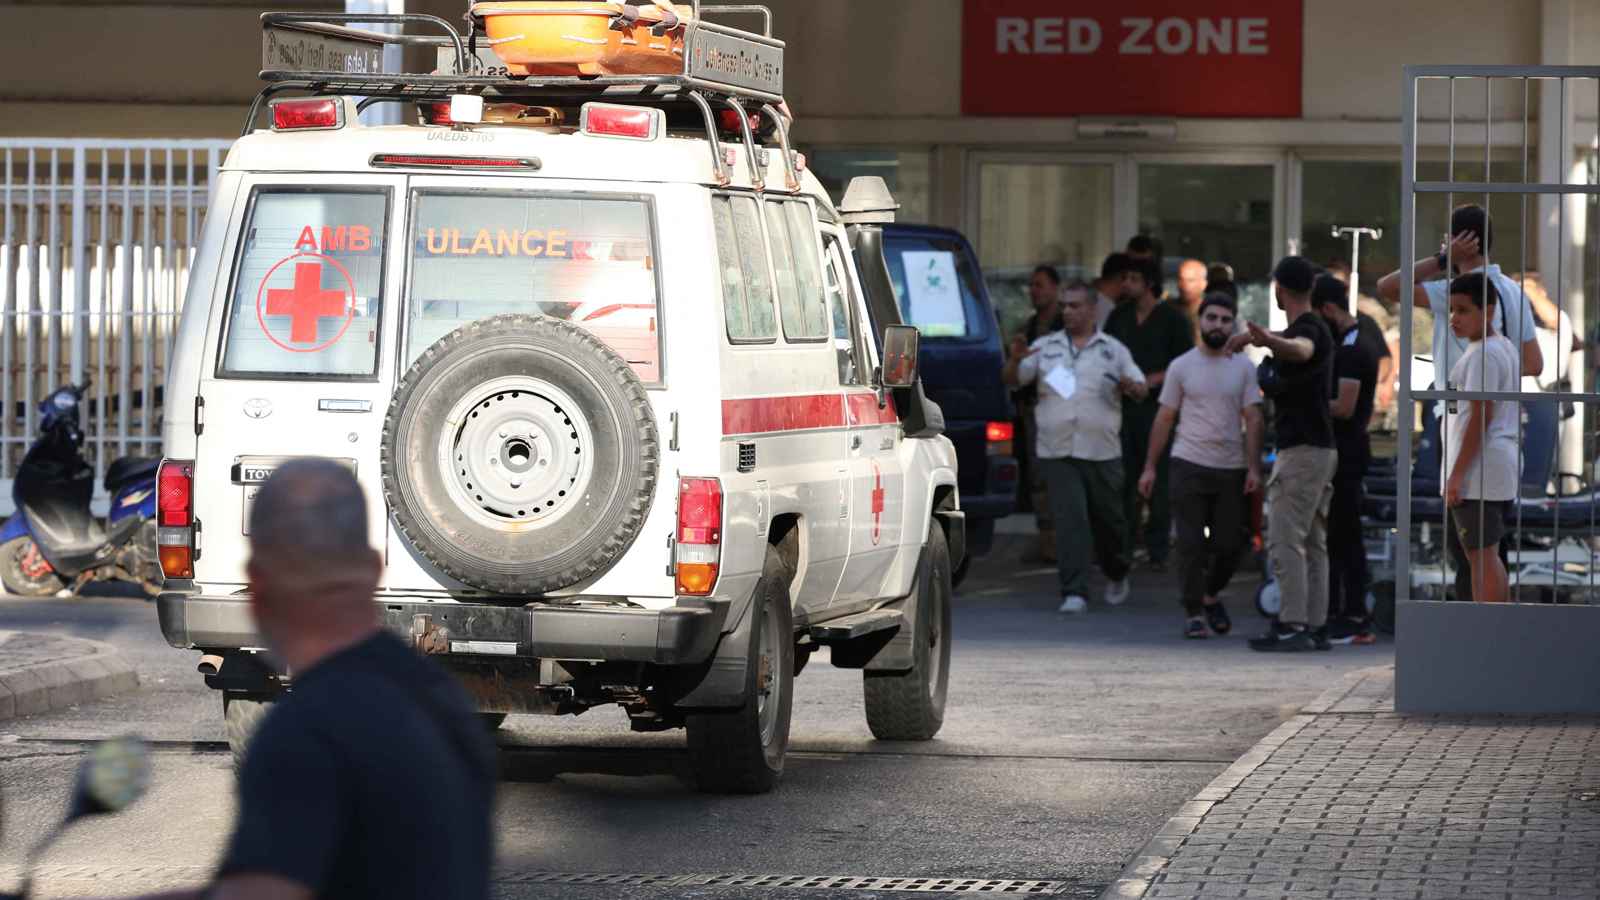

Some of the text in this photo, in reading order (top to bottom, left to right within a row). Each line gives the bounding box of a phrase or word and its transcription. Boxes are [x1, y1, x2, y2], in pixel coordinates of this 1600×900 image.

[995, 17, 1269, 53] RED ZONE
[295, 225, 568, 257] AMB ULANCE
[247, 469, 273, 480] TOY
